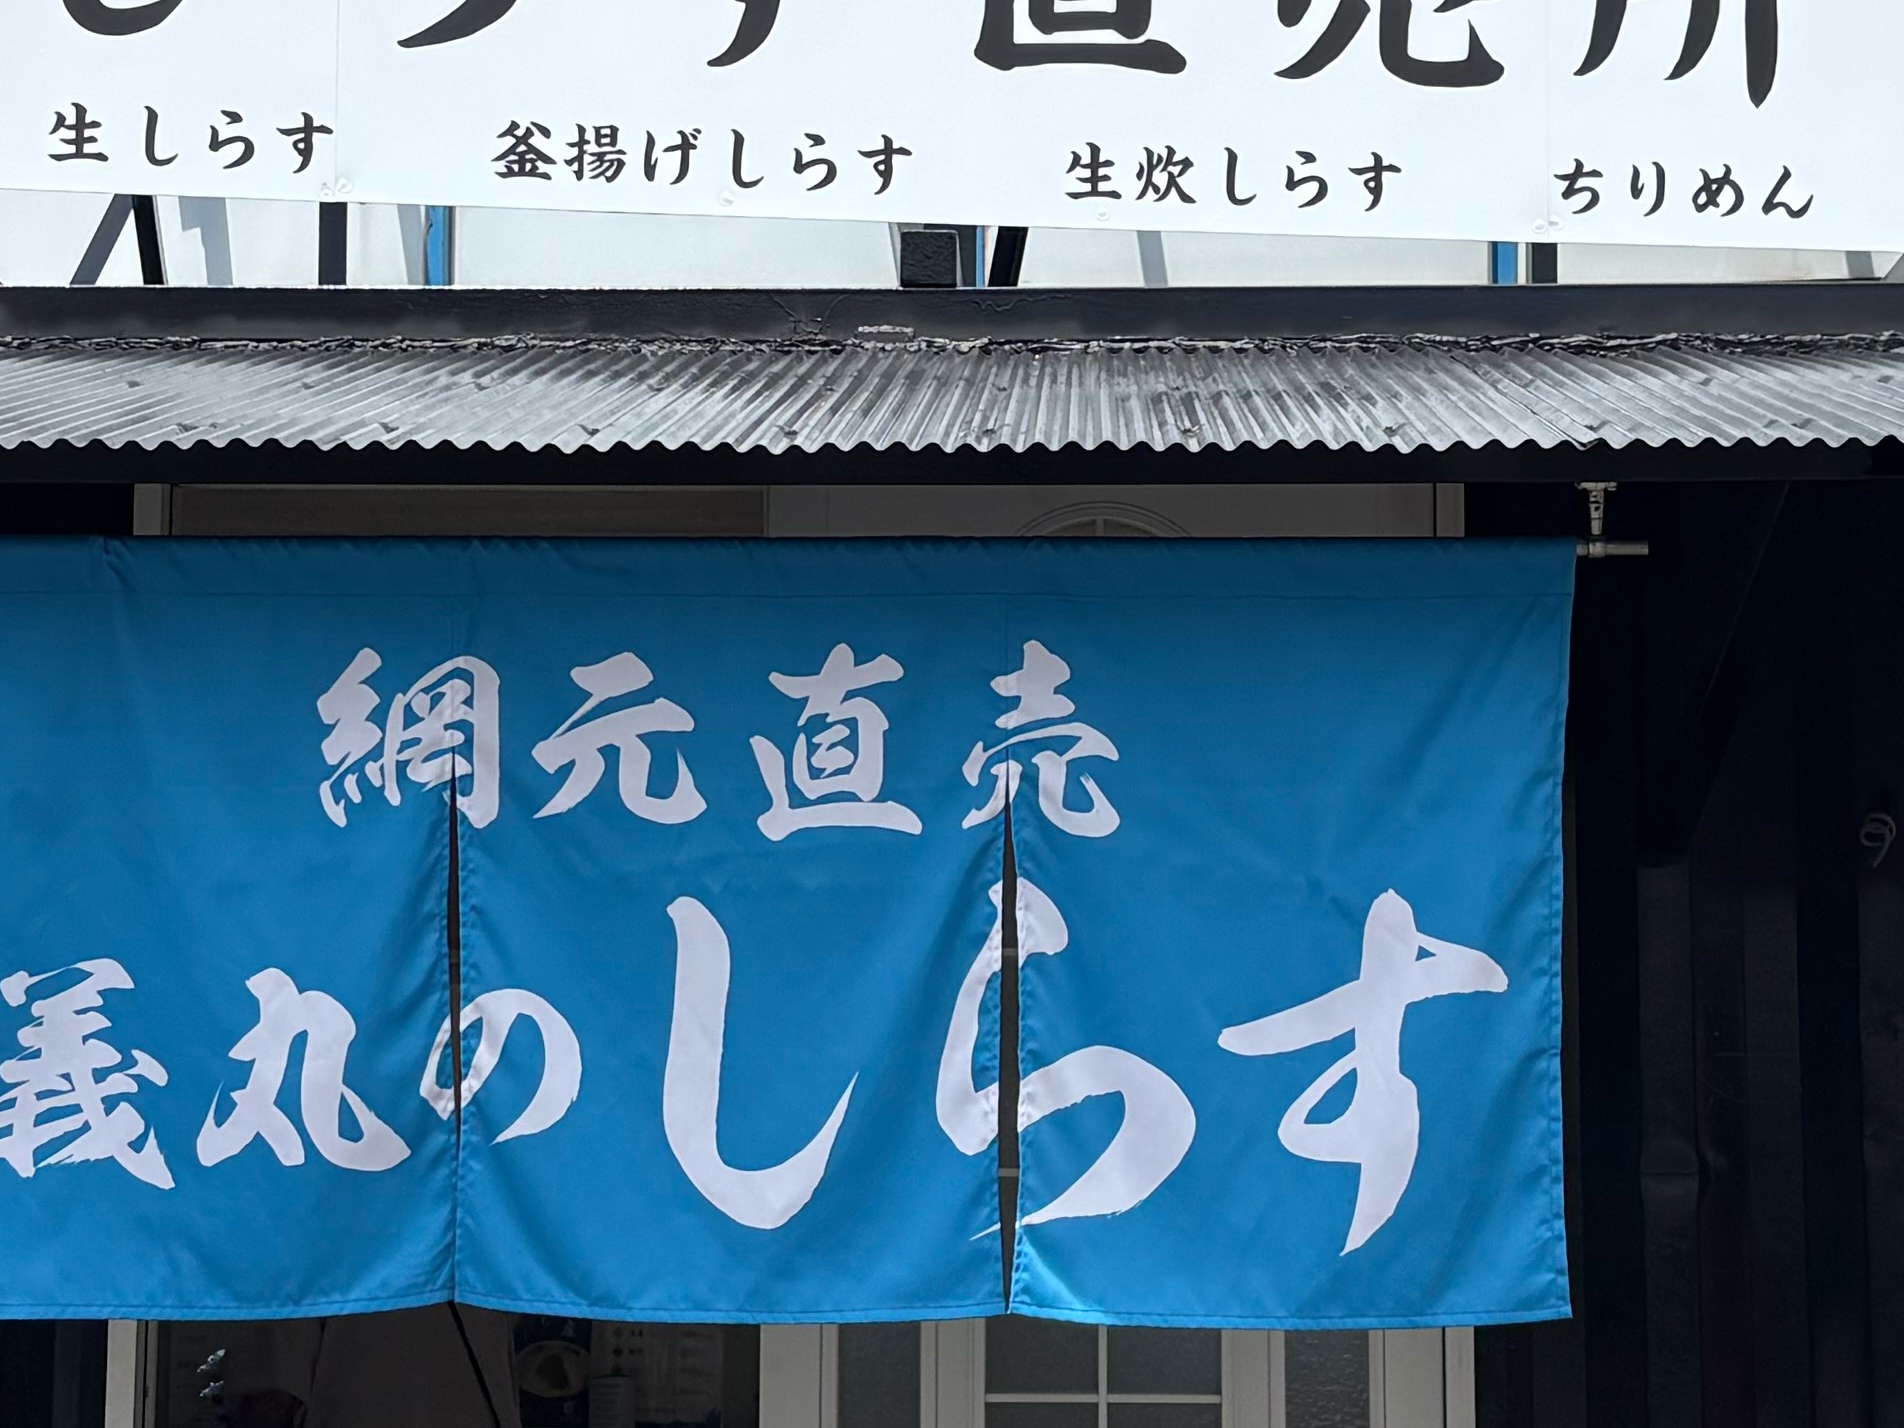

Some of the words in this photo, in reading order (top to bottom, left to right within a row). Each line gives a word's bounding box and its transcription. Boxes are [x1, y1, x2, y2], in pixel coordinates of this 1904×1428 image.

[47, 101, 335, 175] 生しらす
[490, 119, 914, 196] 釜揚げしらす
[1064, 141, 1403, 213] 生炊しらす
[1552, 157, 1815, 220] ちりめん
[314, 638, 1122, 844] 網元直売
